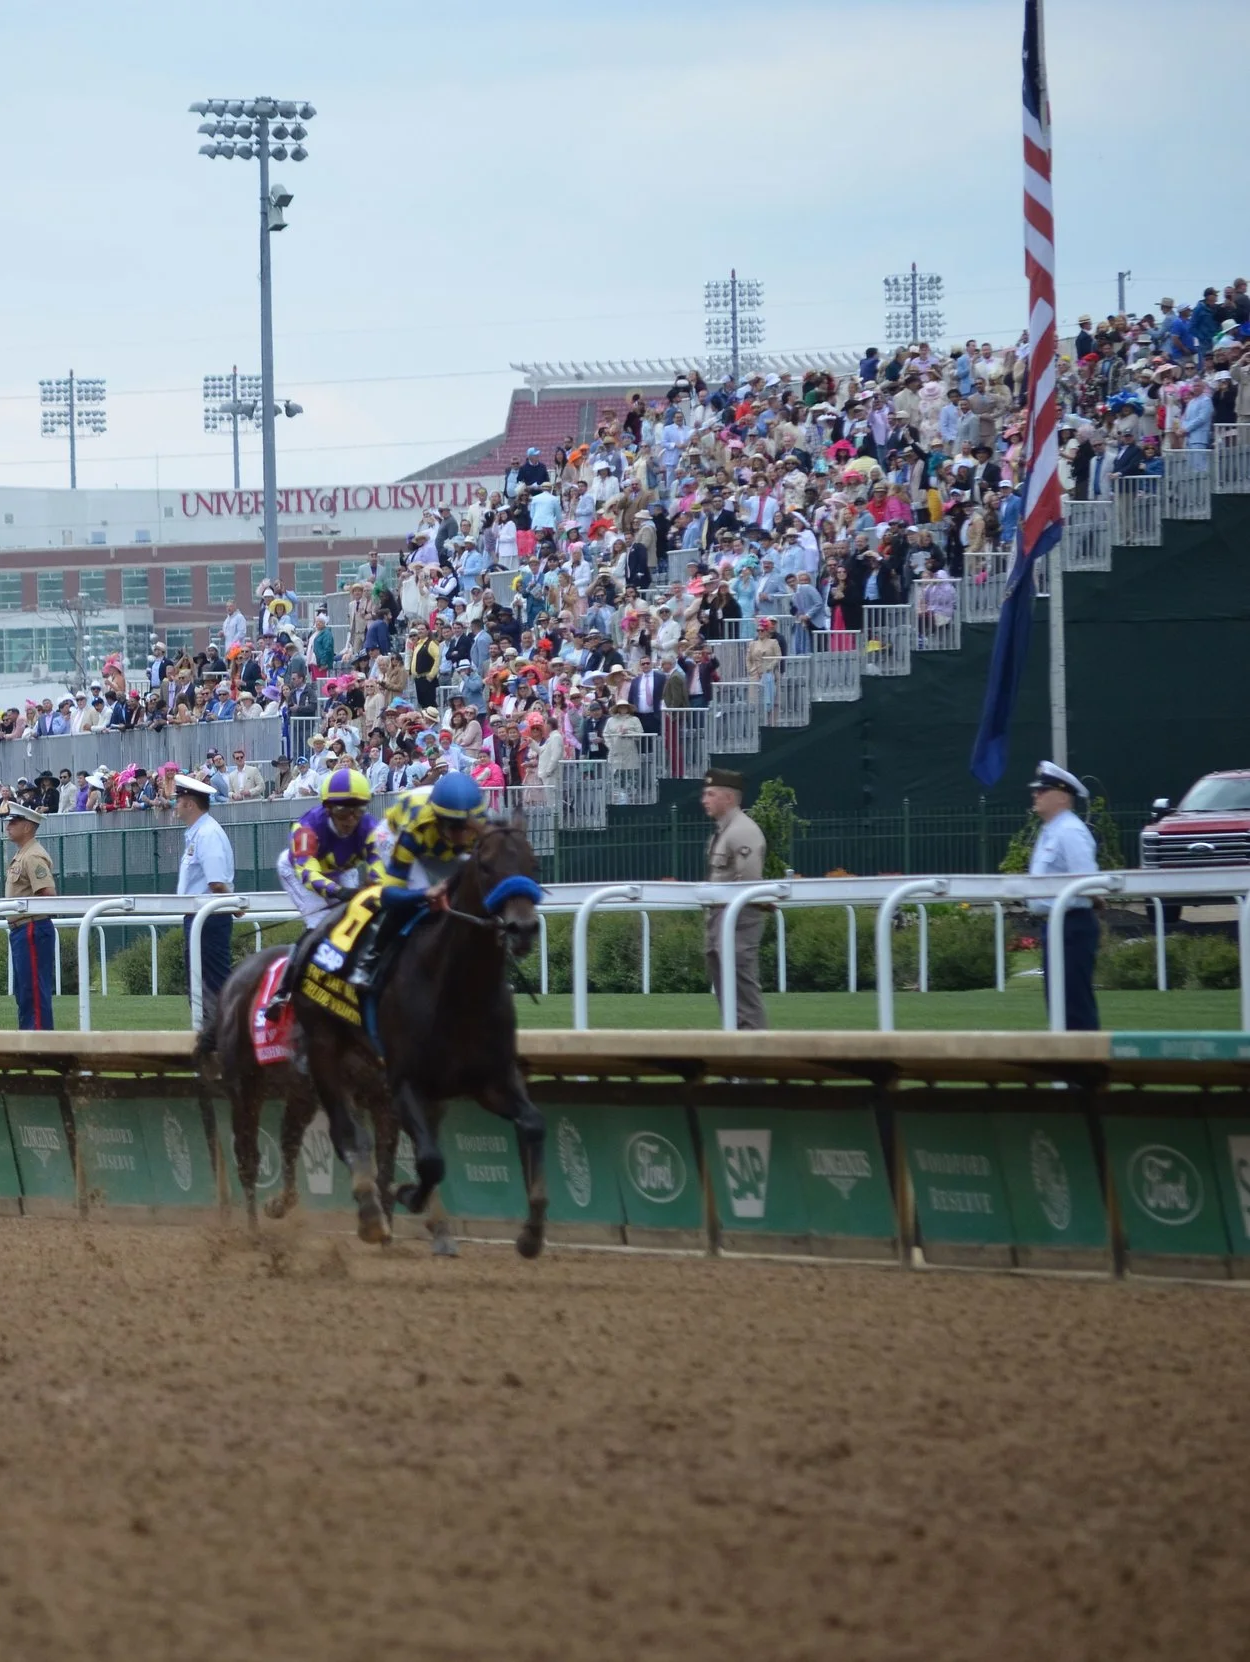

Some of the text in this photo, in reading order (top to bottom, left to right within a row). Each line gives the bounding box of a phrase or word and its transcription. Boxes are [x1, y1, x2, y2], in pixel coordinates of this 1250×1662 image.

[301, 832, 308, 851] 1
[313, 943, 344, 972] SAP
[19, 1126, 61, 1151] LONGINES
[456, 1133, 508, 1153] WOODFORD
[465, 1163, 510, 1183] RESERVE
[636, 1142, 673, 1191] Ford
[1141, 1155, 1190, 1210] Ford
[929, 1186, 994, 1214] RESERVE
